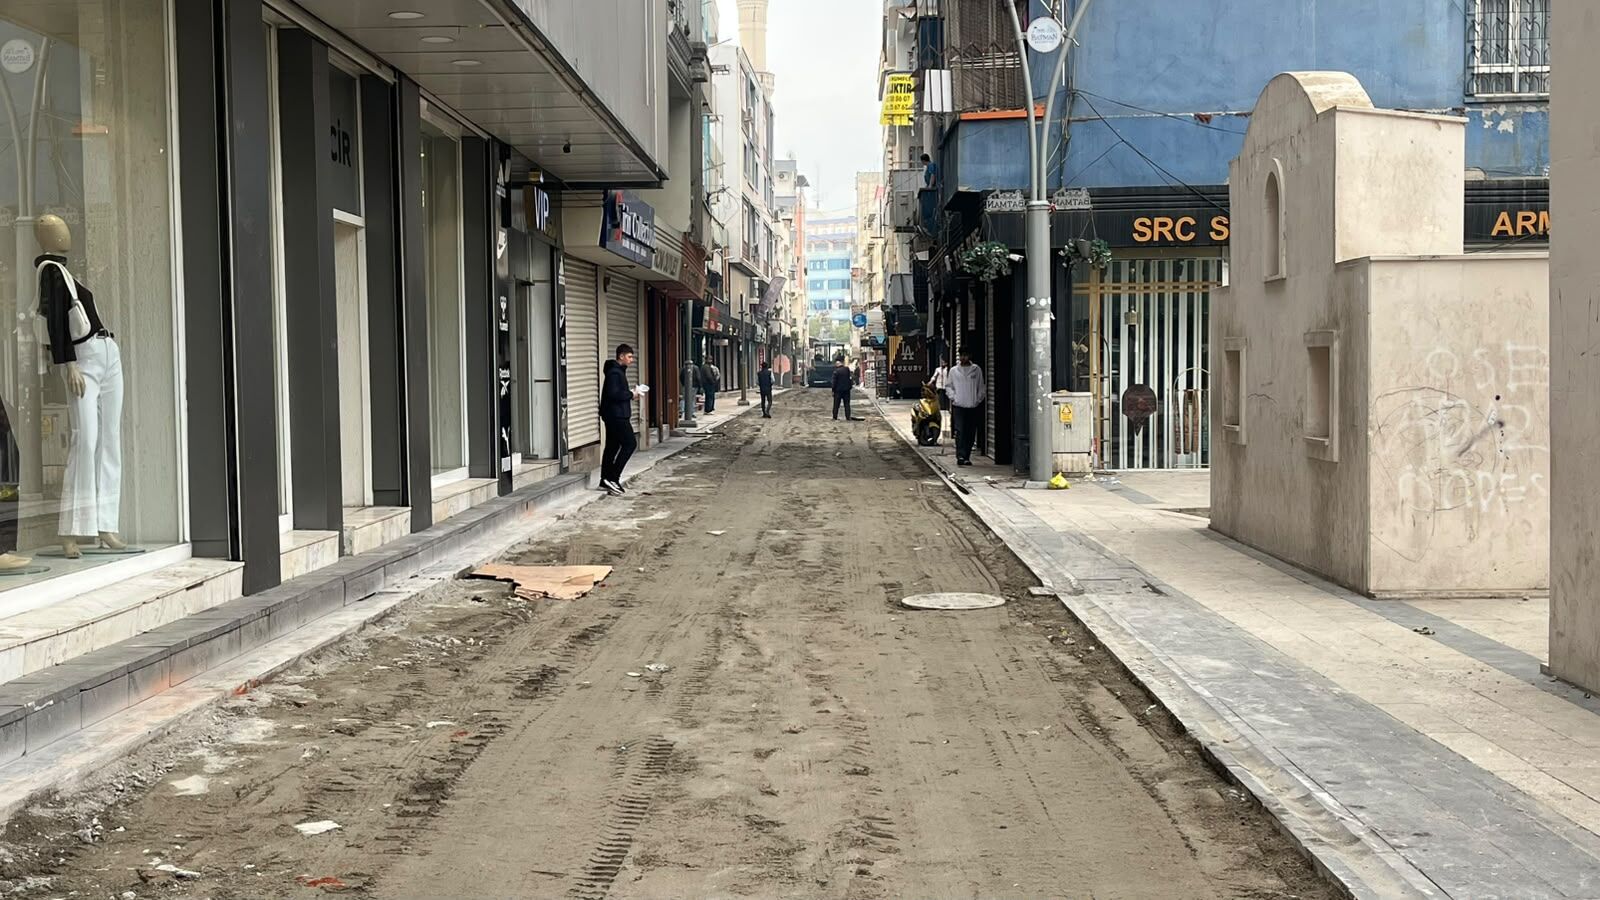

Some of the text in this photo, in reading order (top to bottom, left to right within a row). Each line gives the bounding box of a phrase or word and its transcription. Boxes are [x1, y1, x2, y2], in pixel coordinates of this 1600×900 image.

[534, 186, 549, 231] VIP
[1132, 216, 1196, 242] SRC
[901, 341, 914, 360] LA
